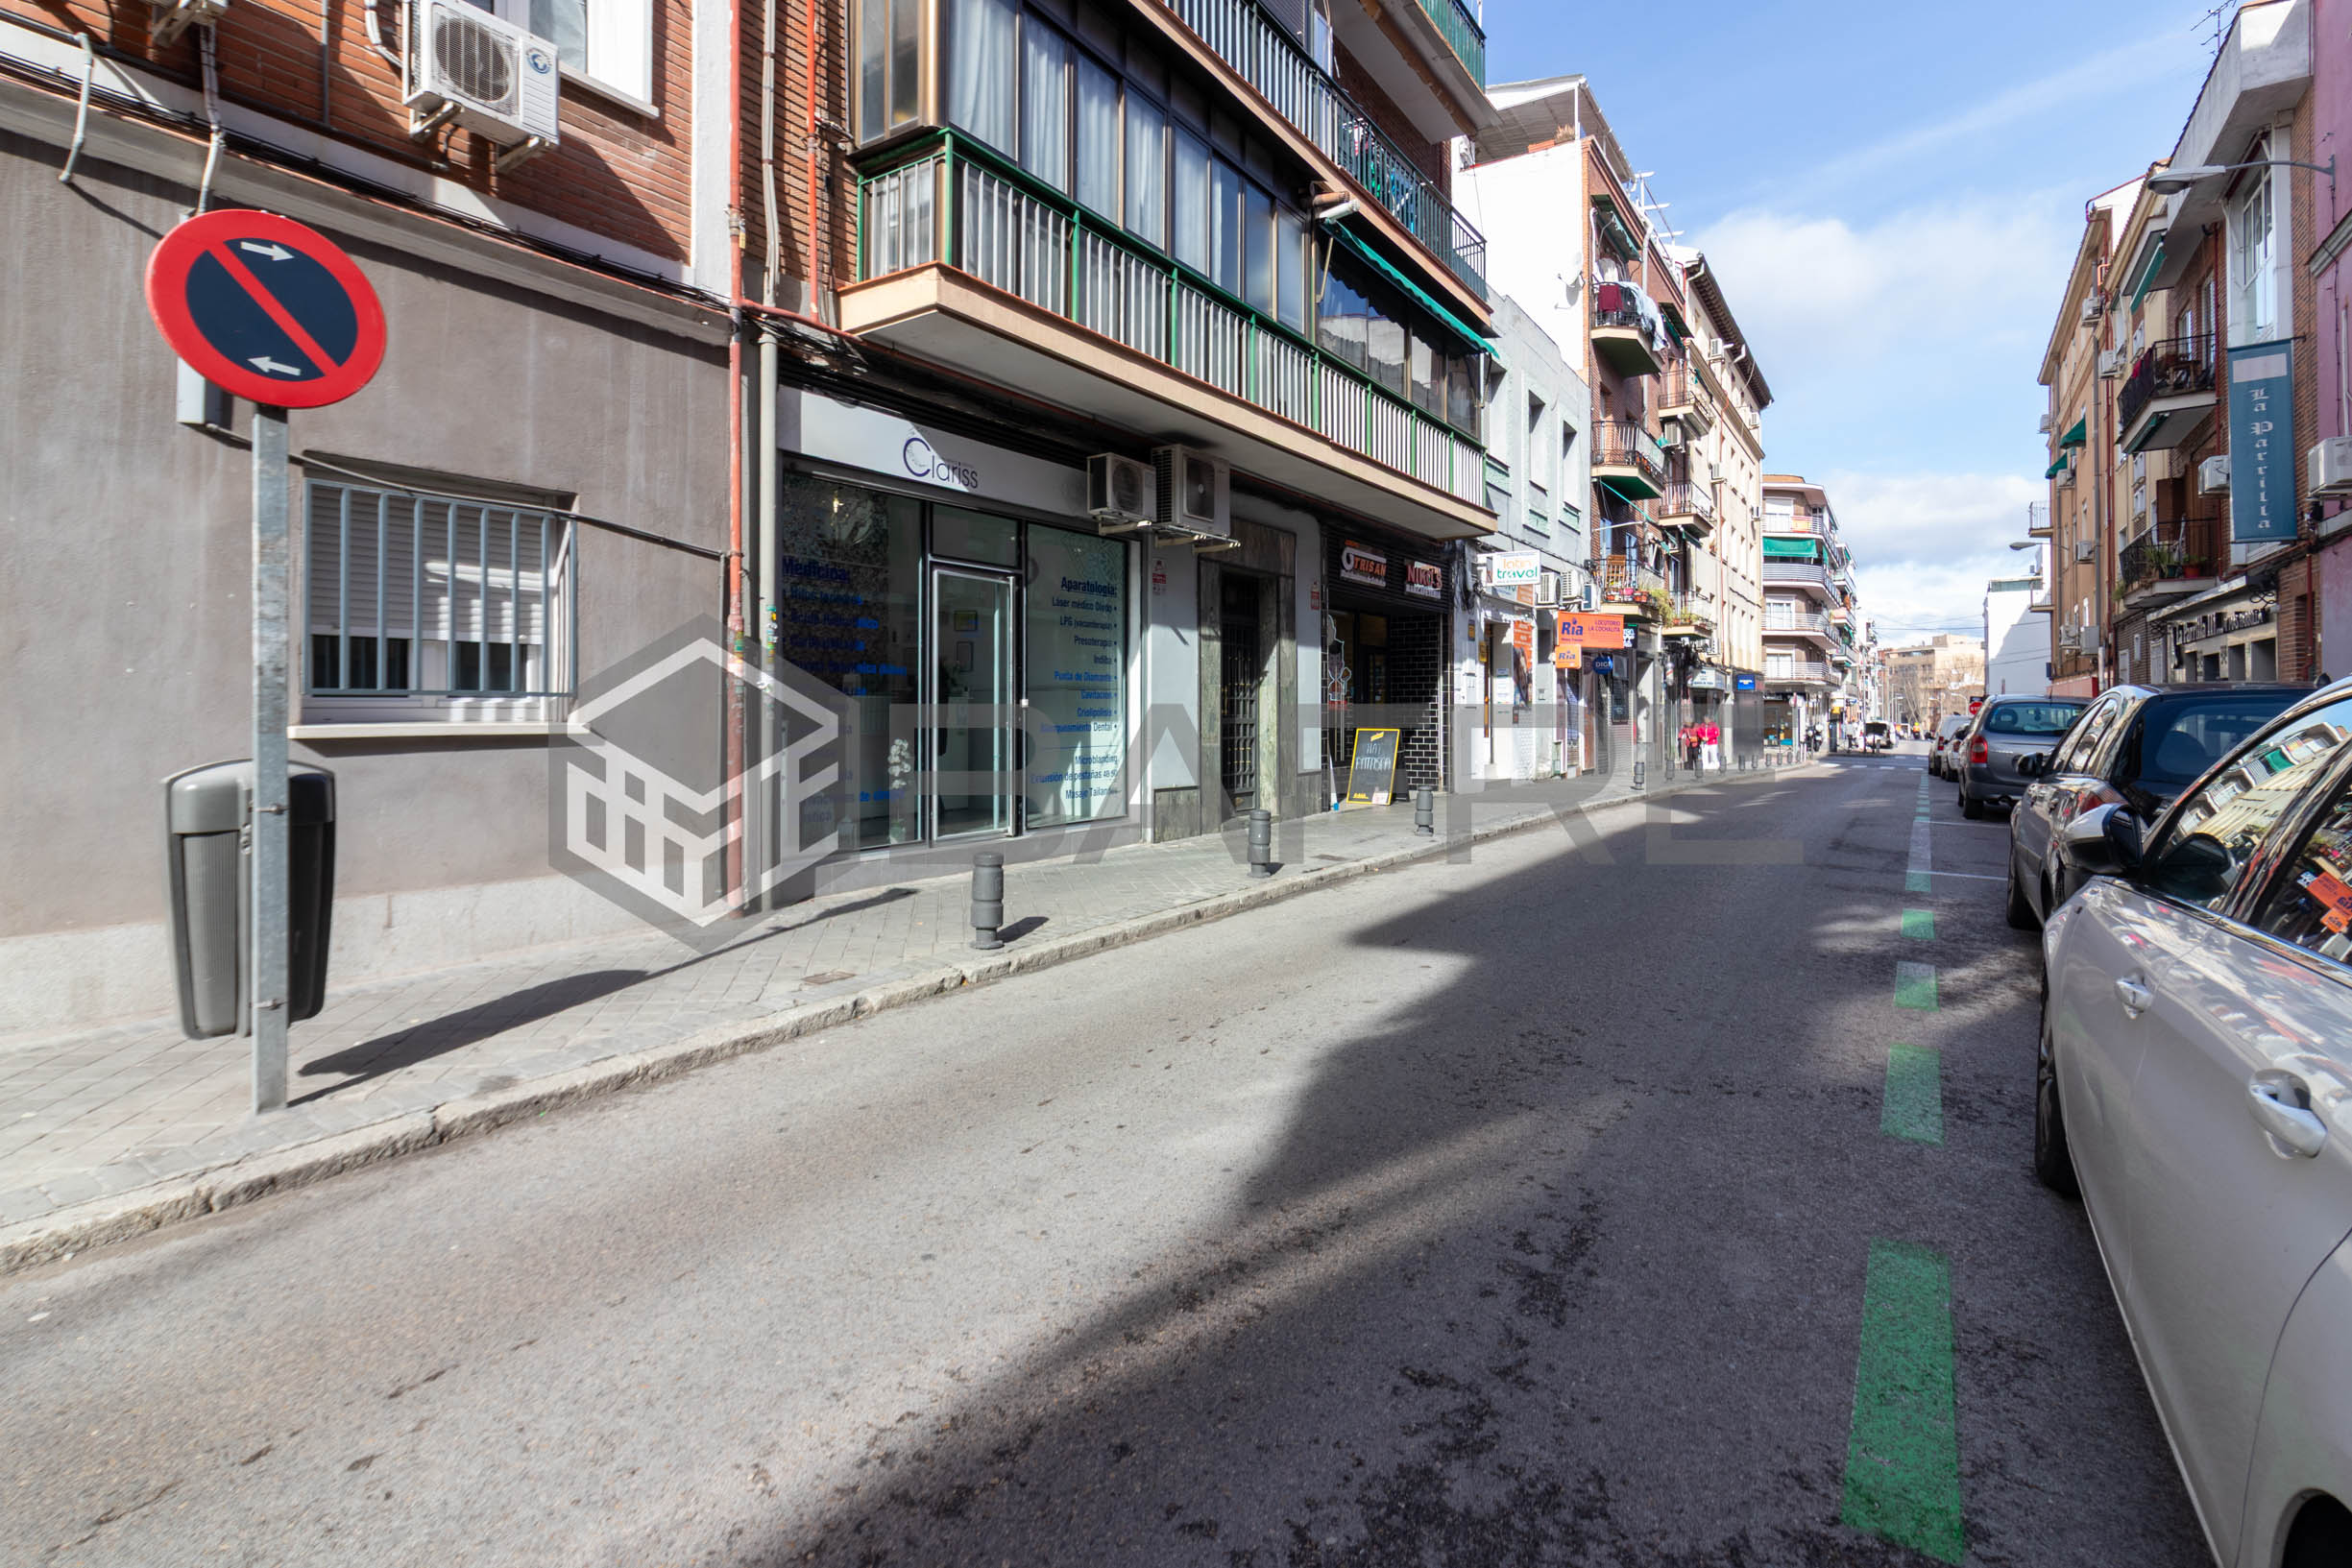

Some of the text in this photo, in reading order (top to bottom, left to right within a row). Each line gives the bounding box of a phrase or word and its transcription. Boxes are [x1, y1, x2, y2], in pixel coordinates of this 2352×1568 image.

[903, 437, 979, 489] Clariss
[2248, 388, 2273, 528] La Parrilla
[1497, 566, 1538, 579] travel
[1060, 615, 1074, 626] LPG
[1562, 617, 1584, 636] Ria
[1559, 650, 1576, 660] Ria
[1093, 721, 1112, 732] Dental
